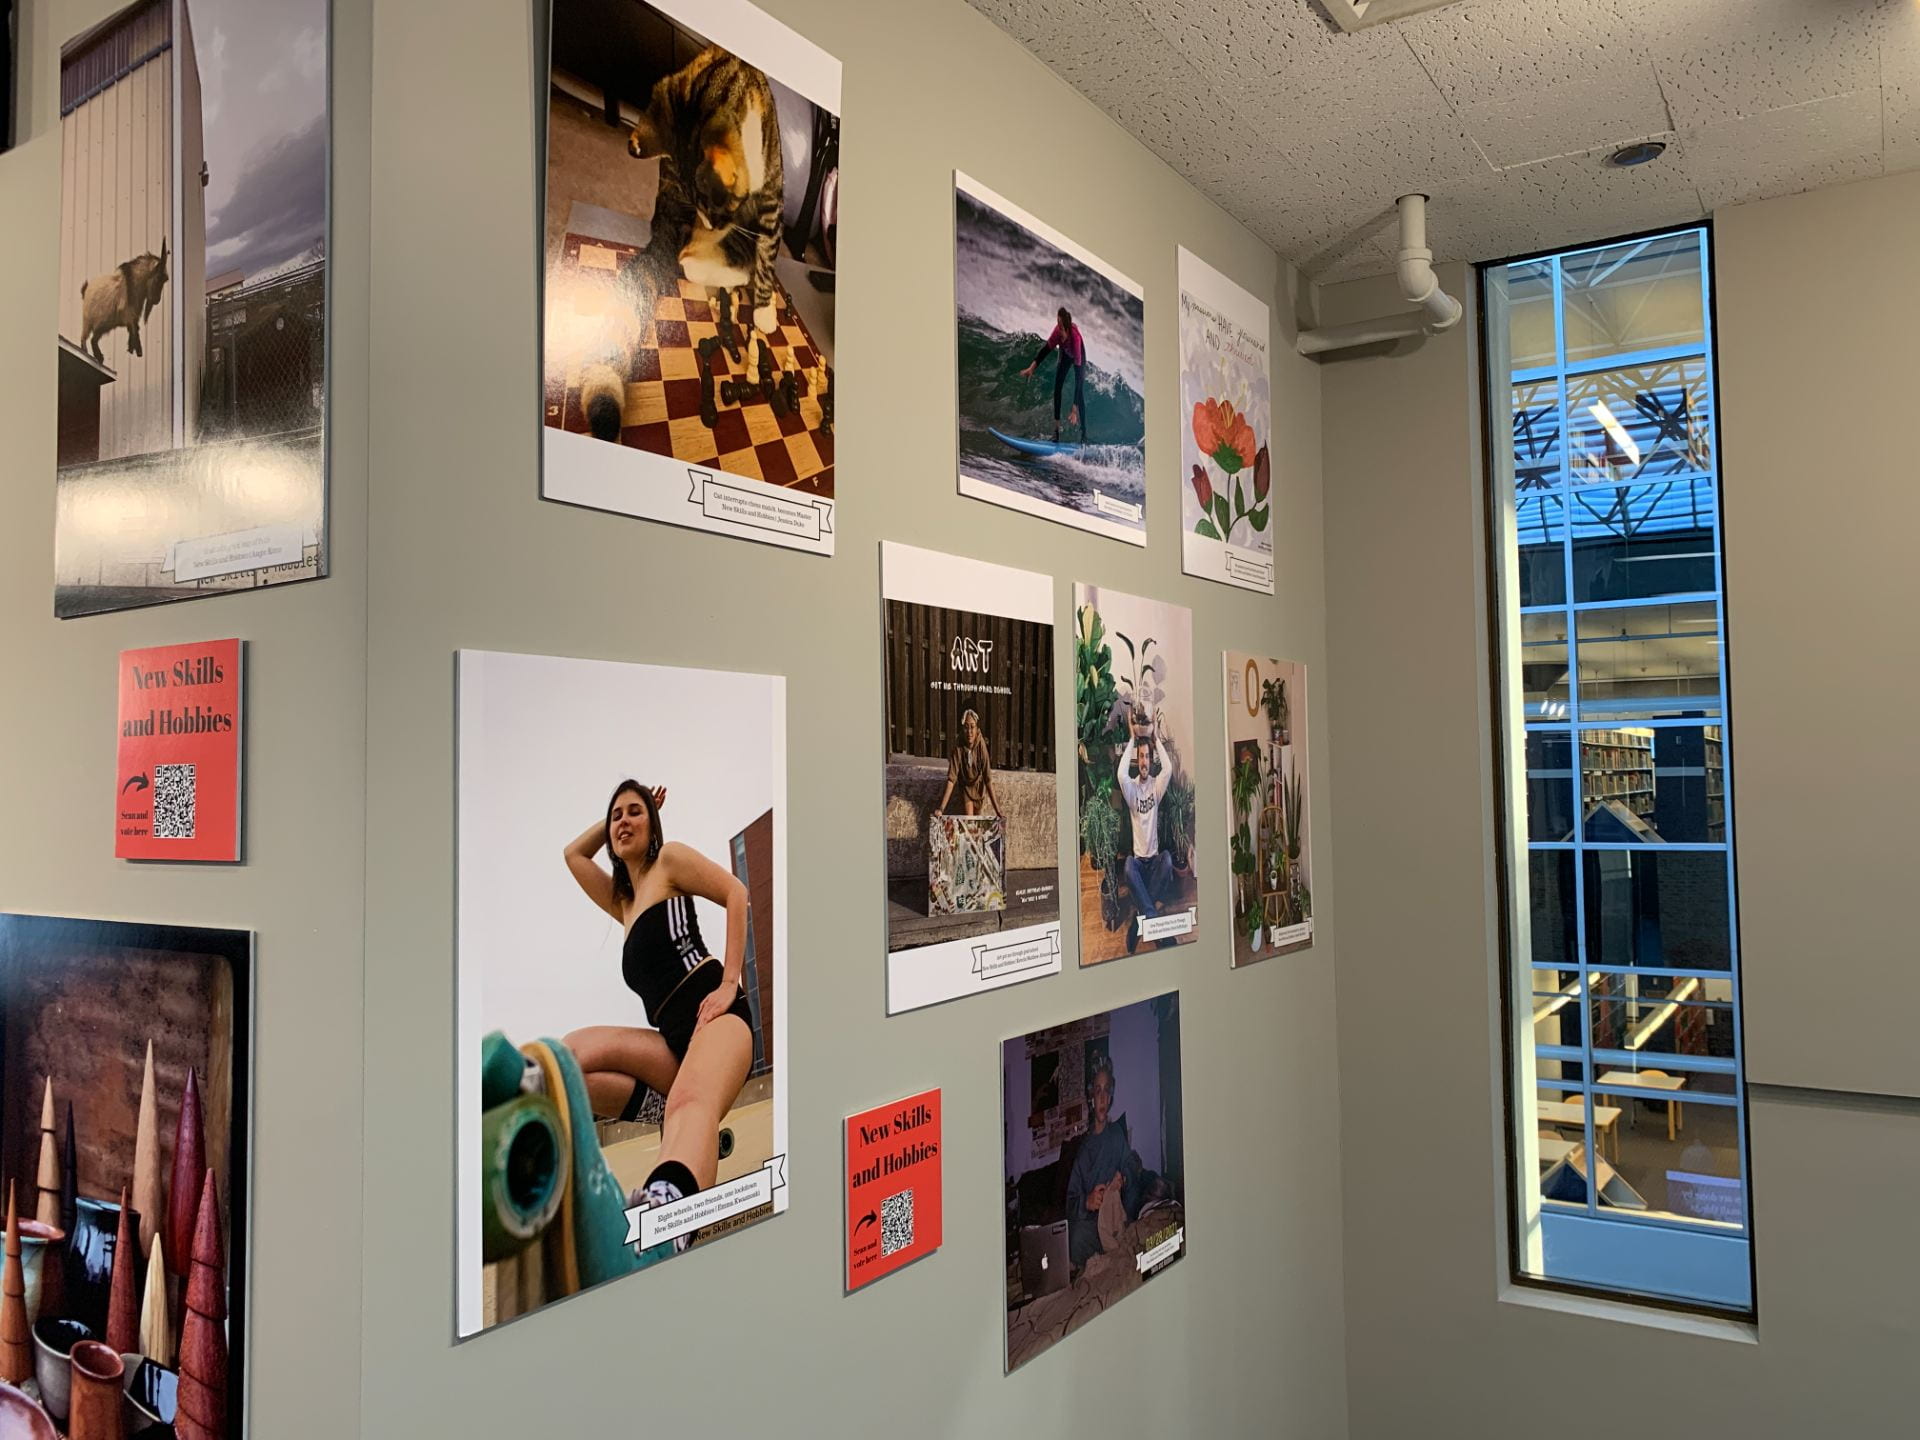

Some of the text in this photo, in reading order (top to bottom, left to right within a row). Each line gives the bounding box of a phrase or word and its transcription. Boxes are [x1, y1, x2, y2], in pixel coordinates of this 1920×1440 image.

[951, 636, 993, 674] ART
[132, 656, 224, 690] New Skills
[122, 706, 232, 738] and Hobbies
[120, 825, 148, 837] vote here
[121, 809, 149, 821] Scan and
[860, 1104, 932, 1148] New Skills
[852, 1141, 938, 1188] and Hobbies
[654, 1224, 667, 1235] New
[667, 1218, 683, 1231] Skills
[683, 1214, 694, 1225] and
[694, 1207, 715, 1221] Hobbies
[657, 1211, 673, 1224] Eight
[693, 1200, 705, 1210] two
[696, 1204, 774, 1242] New Skills and Hobbies
[853, 1252, 878, 1270] vote here
